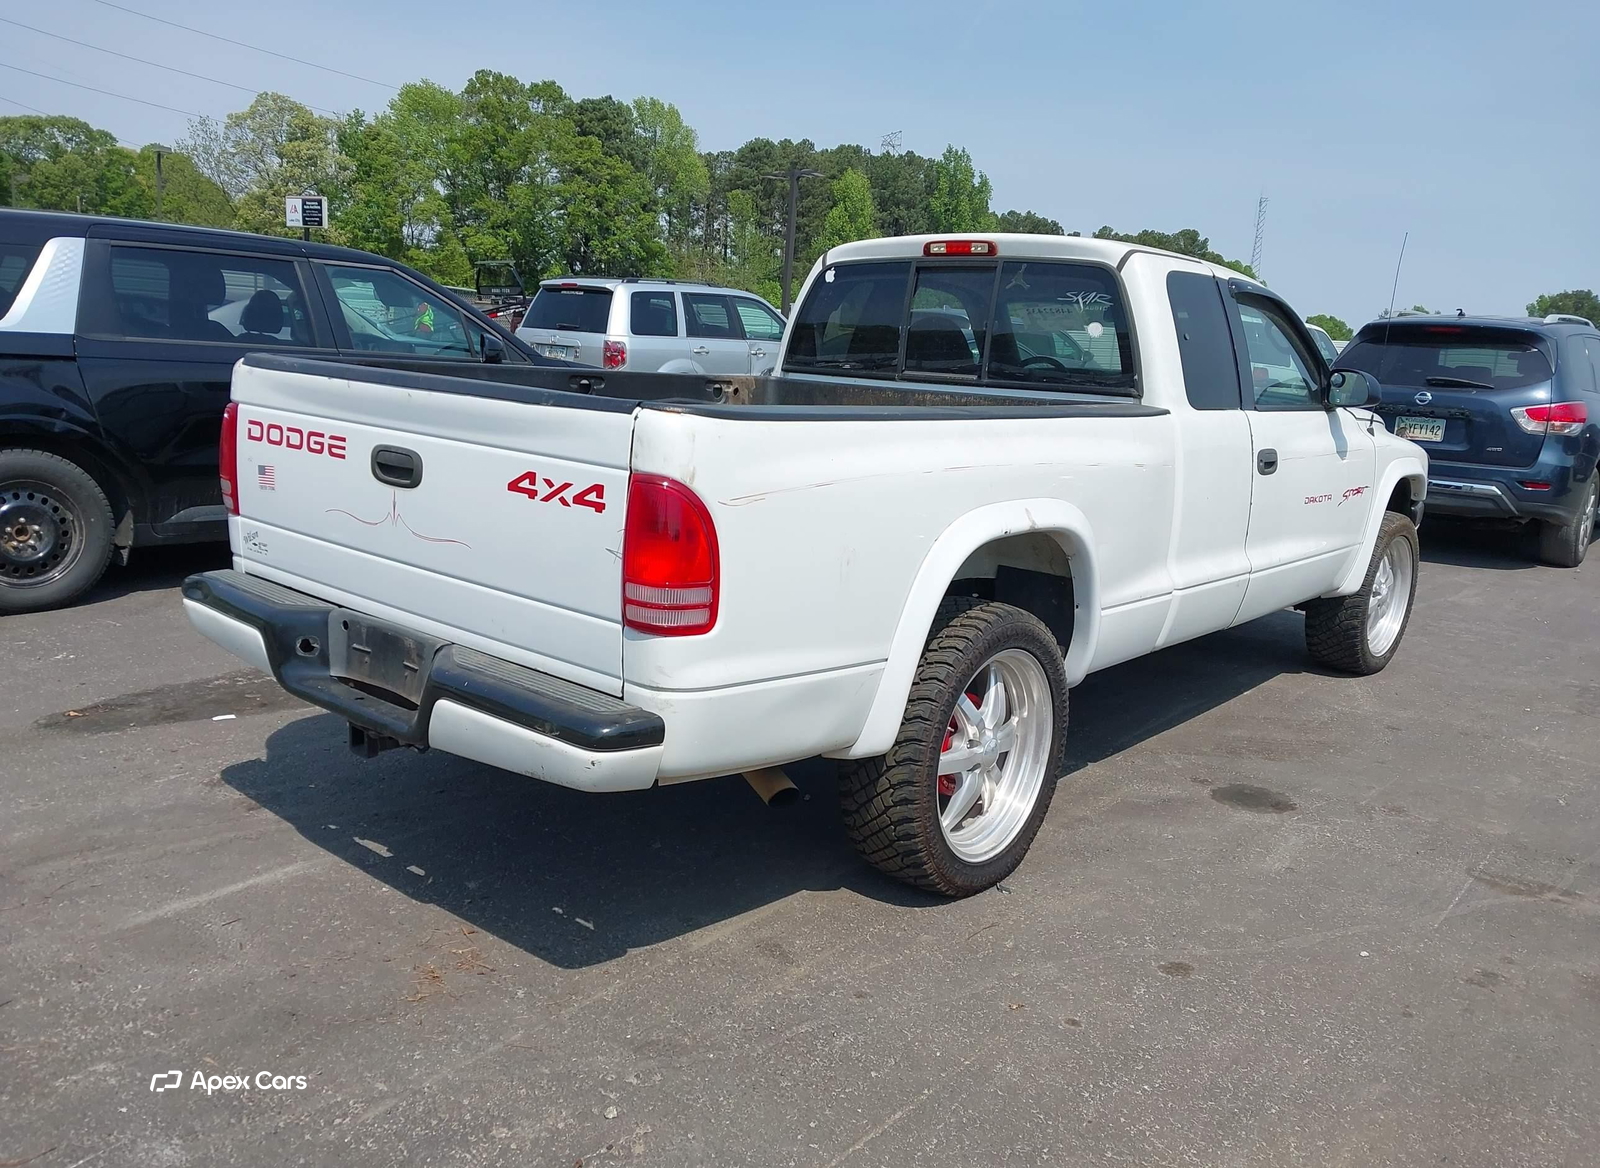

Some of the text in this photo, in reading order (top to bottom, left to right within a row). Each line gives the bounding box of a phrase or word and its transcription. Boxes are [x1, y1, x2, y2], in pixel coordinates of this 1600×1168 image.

[1057, 291, 1114, 313] SKAR
[247, 419, 347, 460] DODGE
[1304, 485, 1370, 507] DAKOTA SPORT
